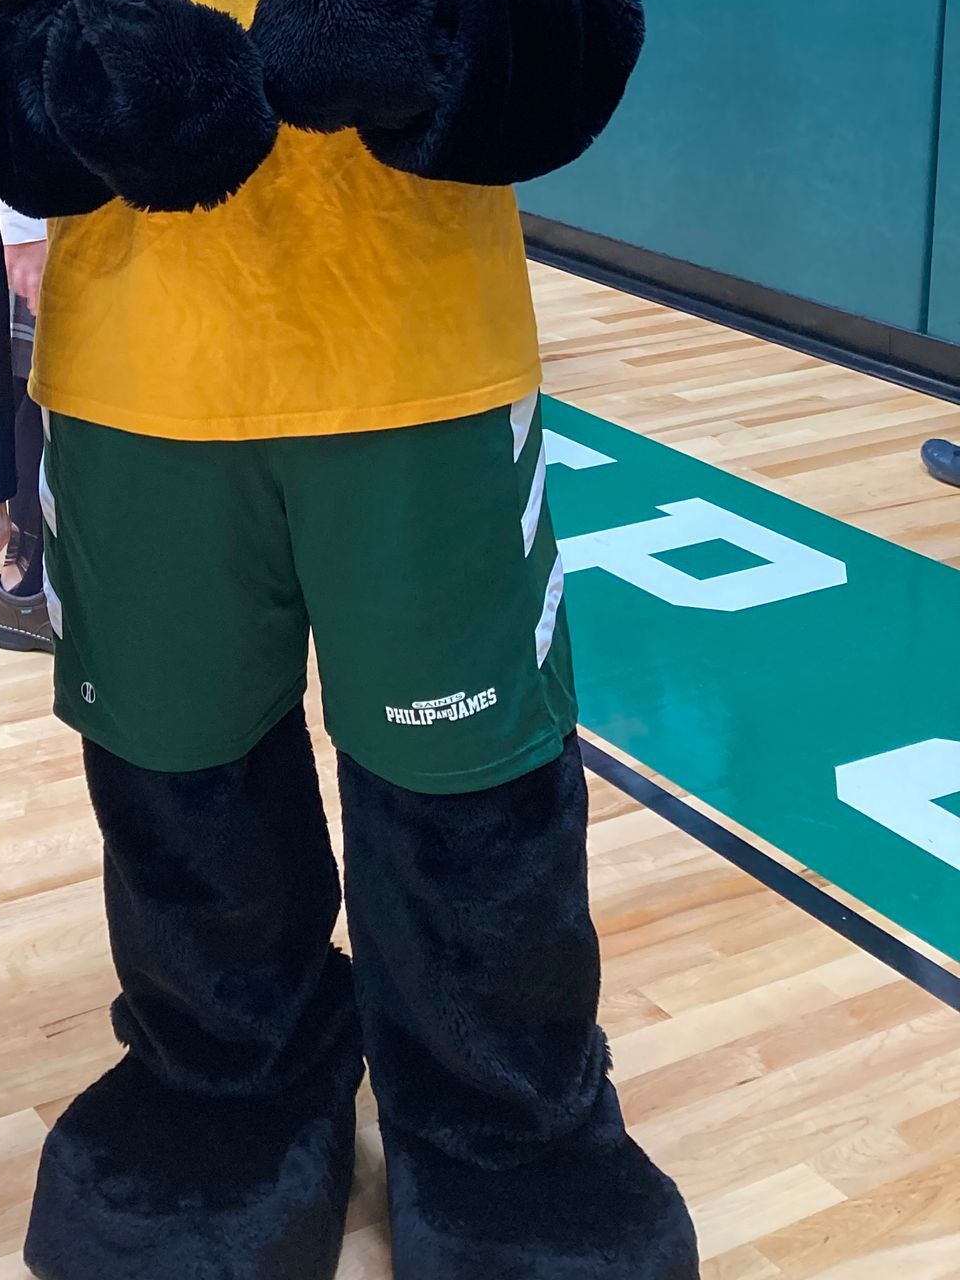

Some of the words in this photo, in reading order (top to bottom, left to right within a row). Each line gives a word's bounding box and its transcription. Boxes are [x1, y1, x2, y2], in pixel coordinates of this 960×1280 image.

[385, 706, 437, 725] PHILIP
[436, 708, 452, 719] AND
[448, 687, 497, 721] JAMES
